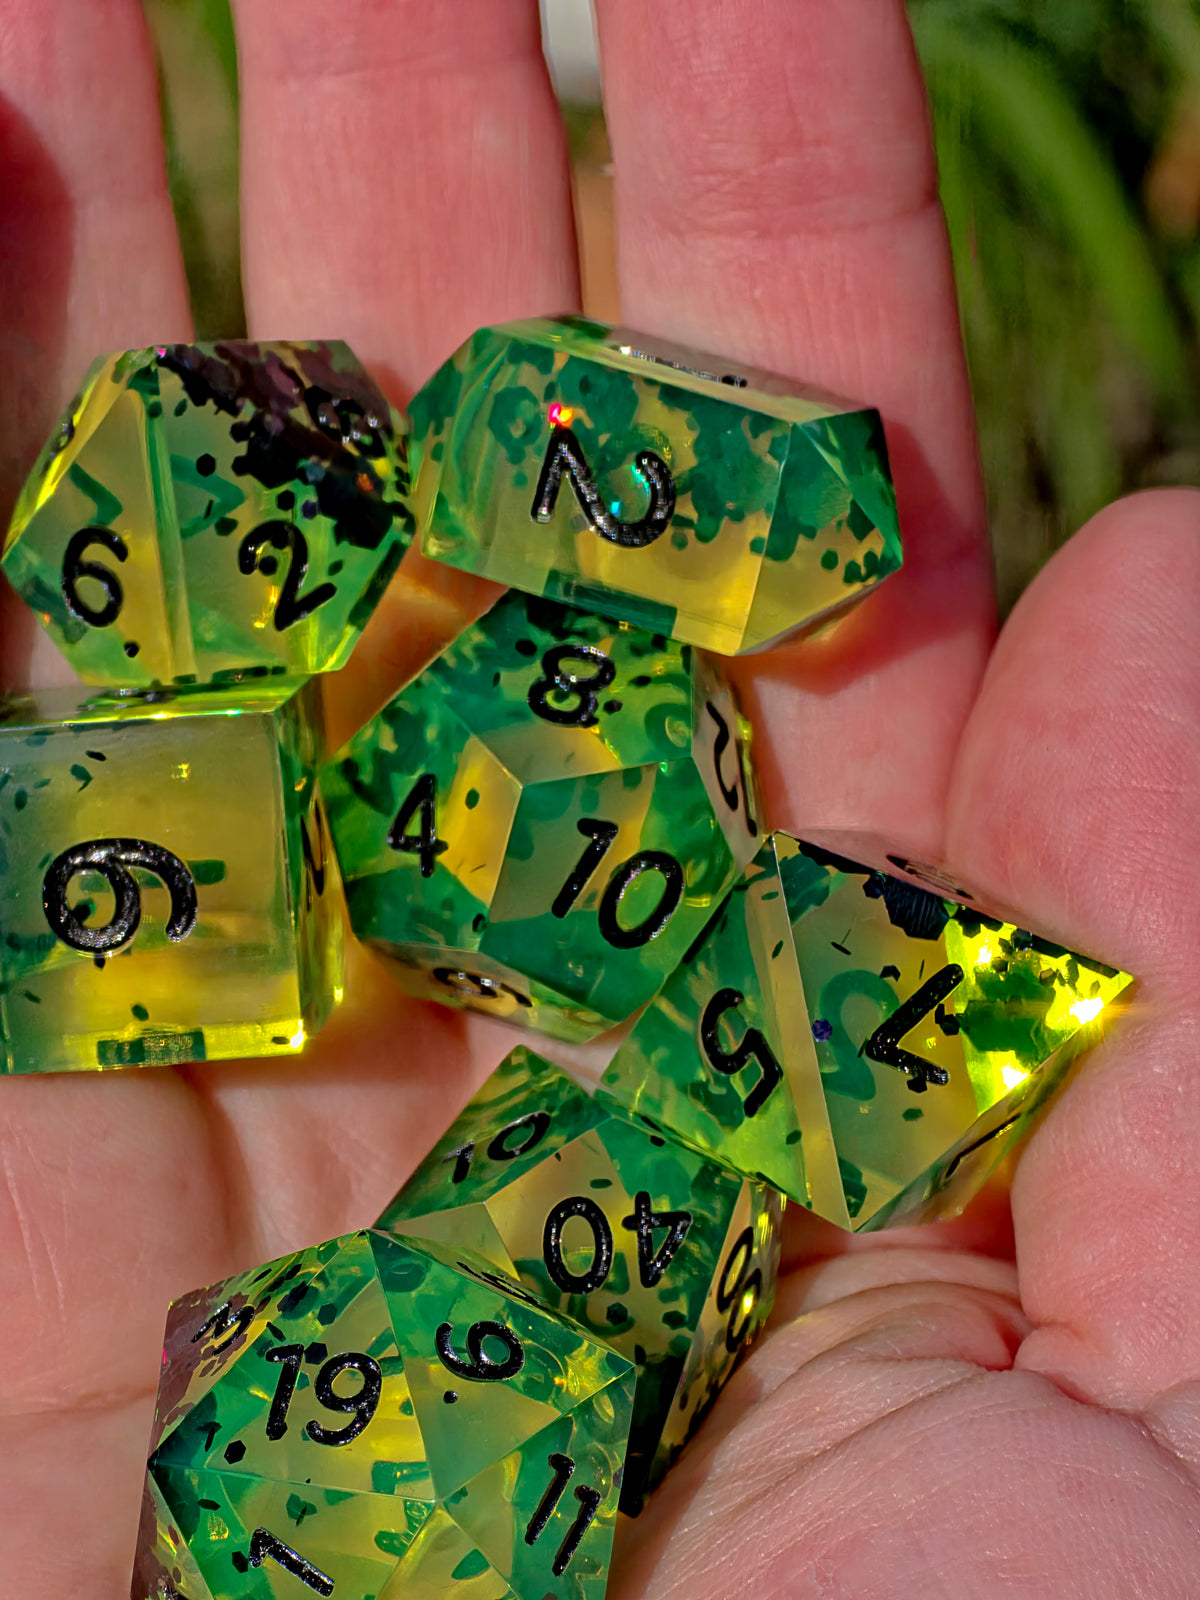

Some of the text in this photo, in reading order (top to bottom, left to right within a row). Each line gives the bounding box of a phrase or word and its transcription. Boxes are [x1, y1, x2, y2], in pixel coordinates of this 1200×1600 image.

[239, 520, 338, 632] 2
[527, 643, 616, 727] 8
[388, 773, 449, 878] 4
[551, 817, 684, 949] 10
[700, 988, 784, 1118] 5
[442, 1110, 552, 1185] 10
[543, 1190, 693, 1295] 40
[191, 1301, 256, 1356] 3
[265, 1343, 383, 1448] 19
[523, 1453, 602, 1578] 11
